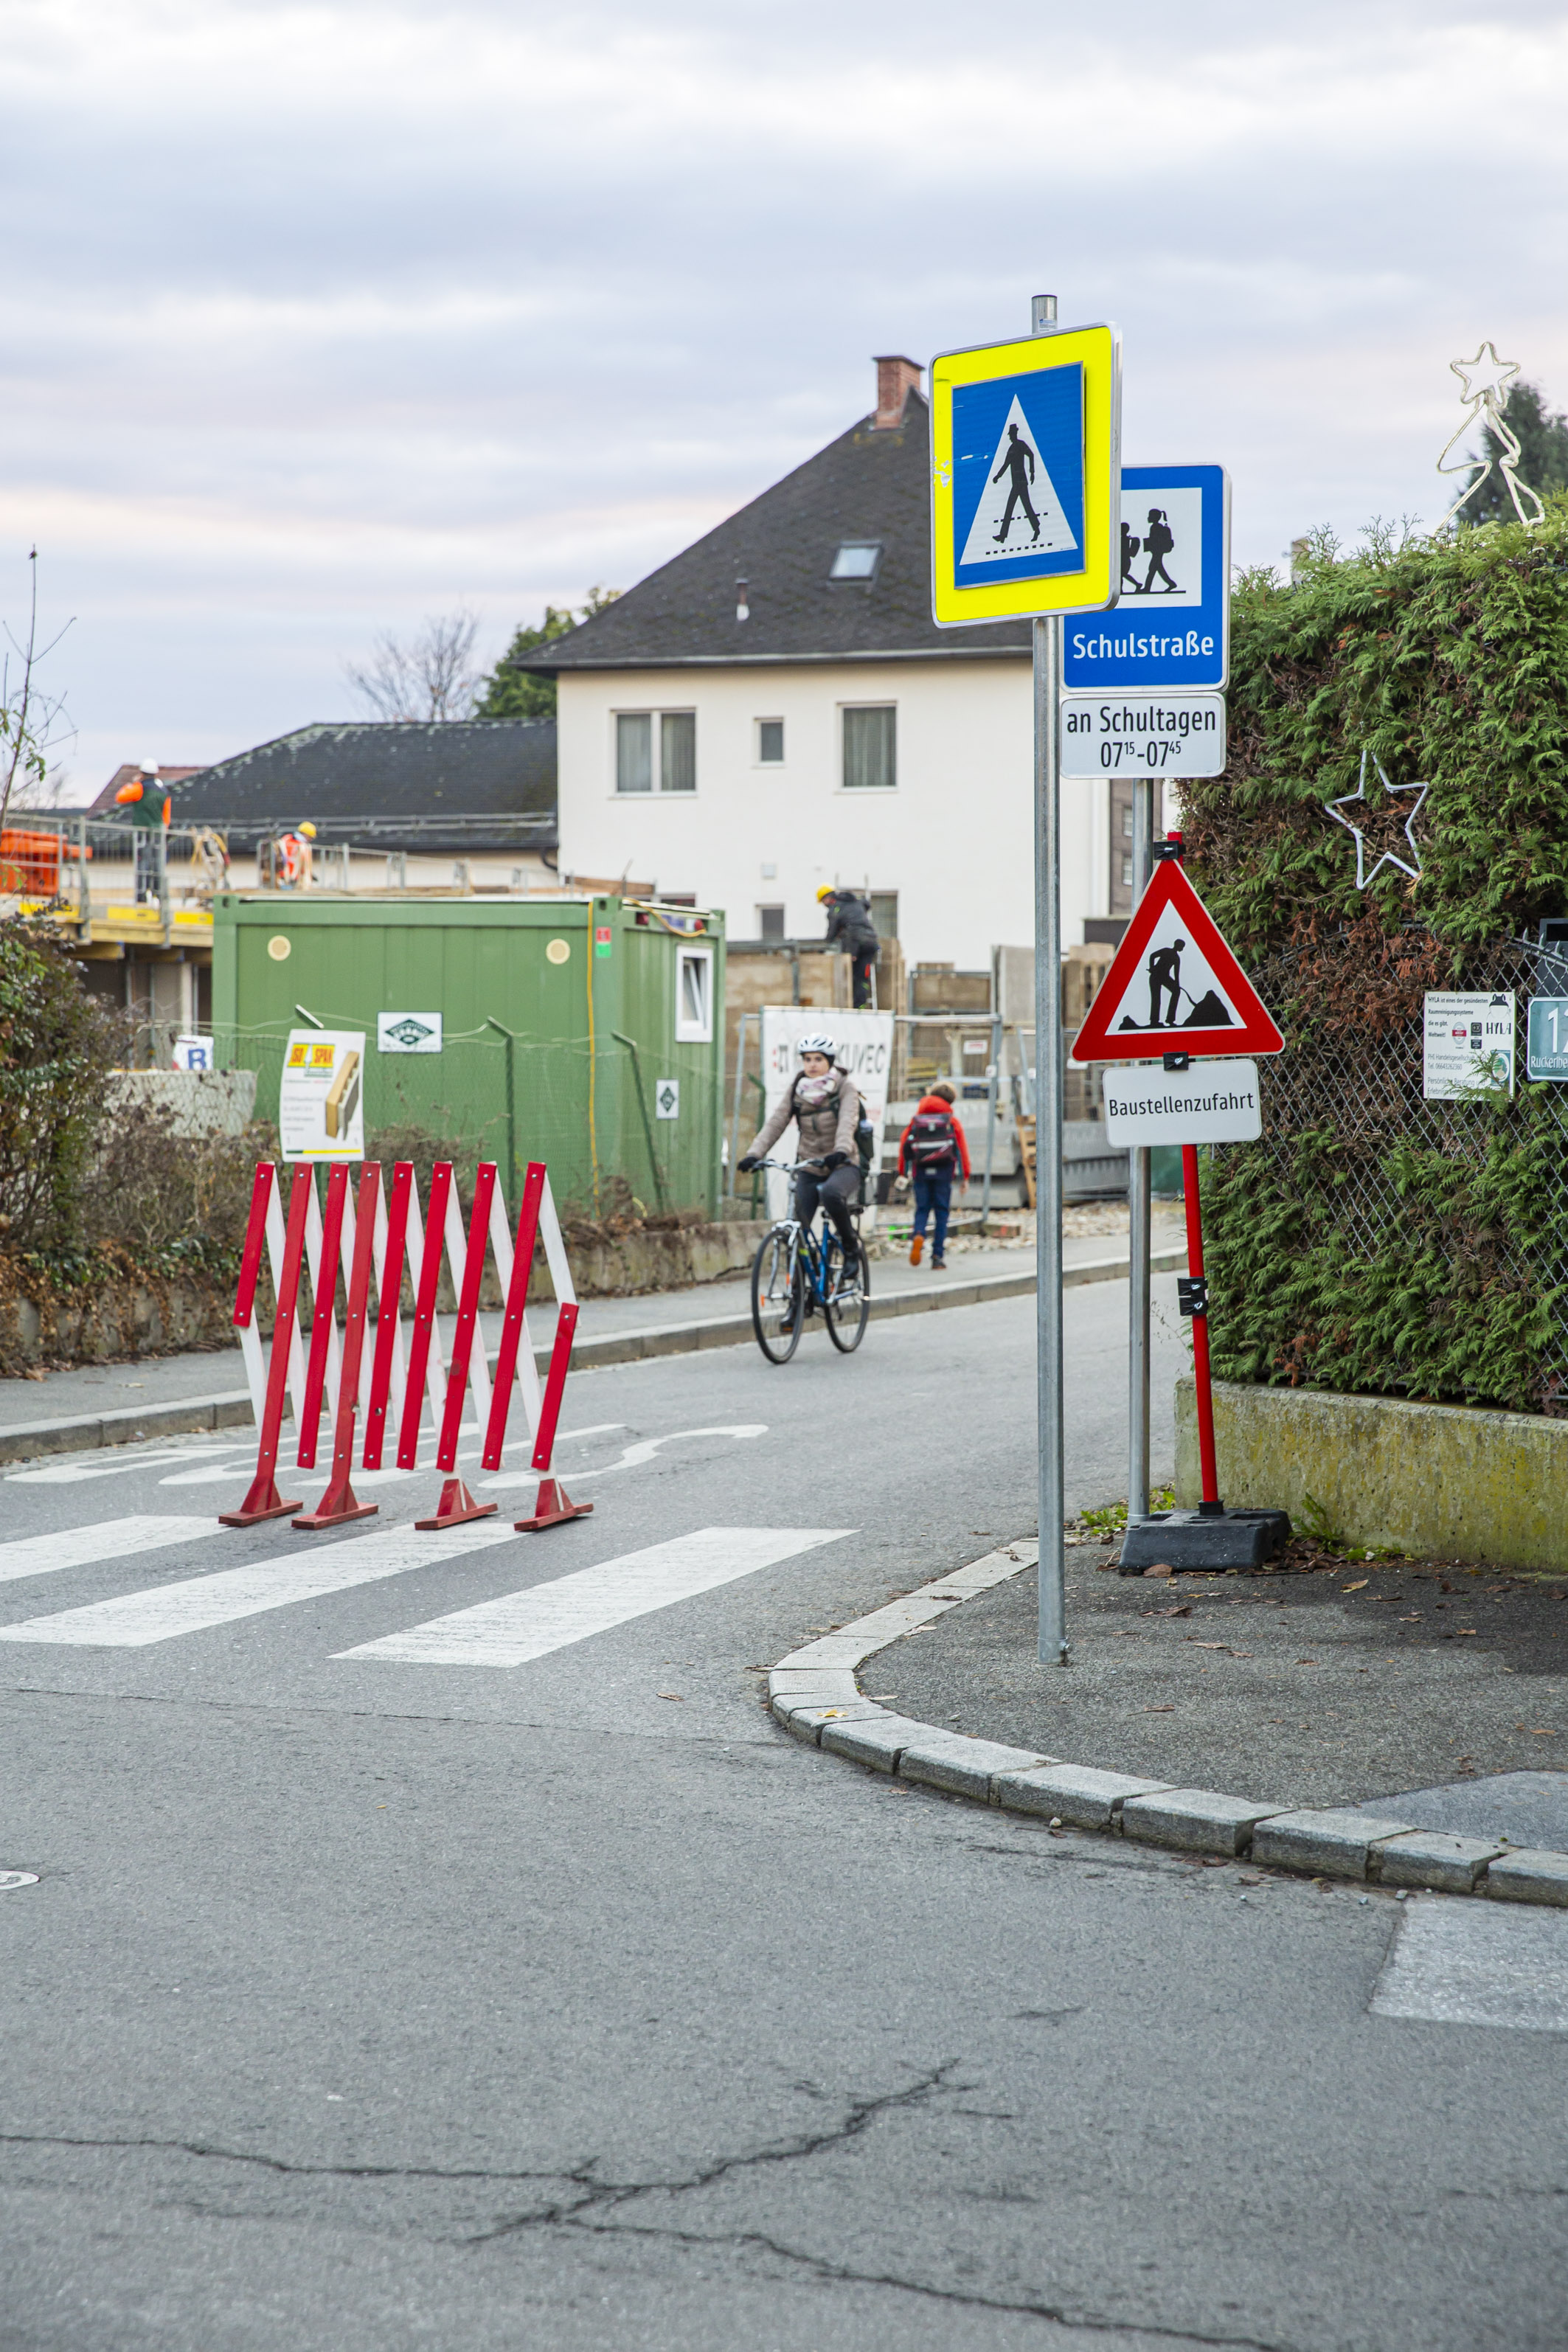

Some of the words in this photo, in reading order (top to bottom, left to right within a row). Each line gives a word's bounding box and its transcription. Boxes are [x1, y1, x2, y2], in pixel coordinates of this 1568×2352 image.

[1073, 631, 1214, 659] Schulstraße
[1067, 713, 1092, 733] an
[1100, 706, 1215, 738] Schultagen
[1486, 1022, 1511, 1035] HYLA
[1530, 1055, 1568, 1069] Ruckerlbe
[1109, 1092, 1255, 1117] Baustellenzufahrt
